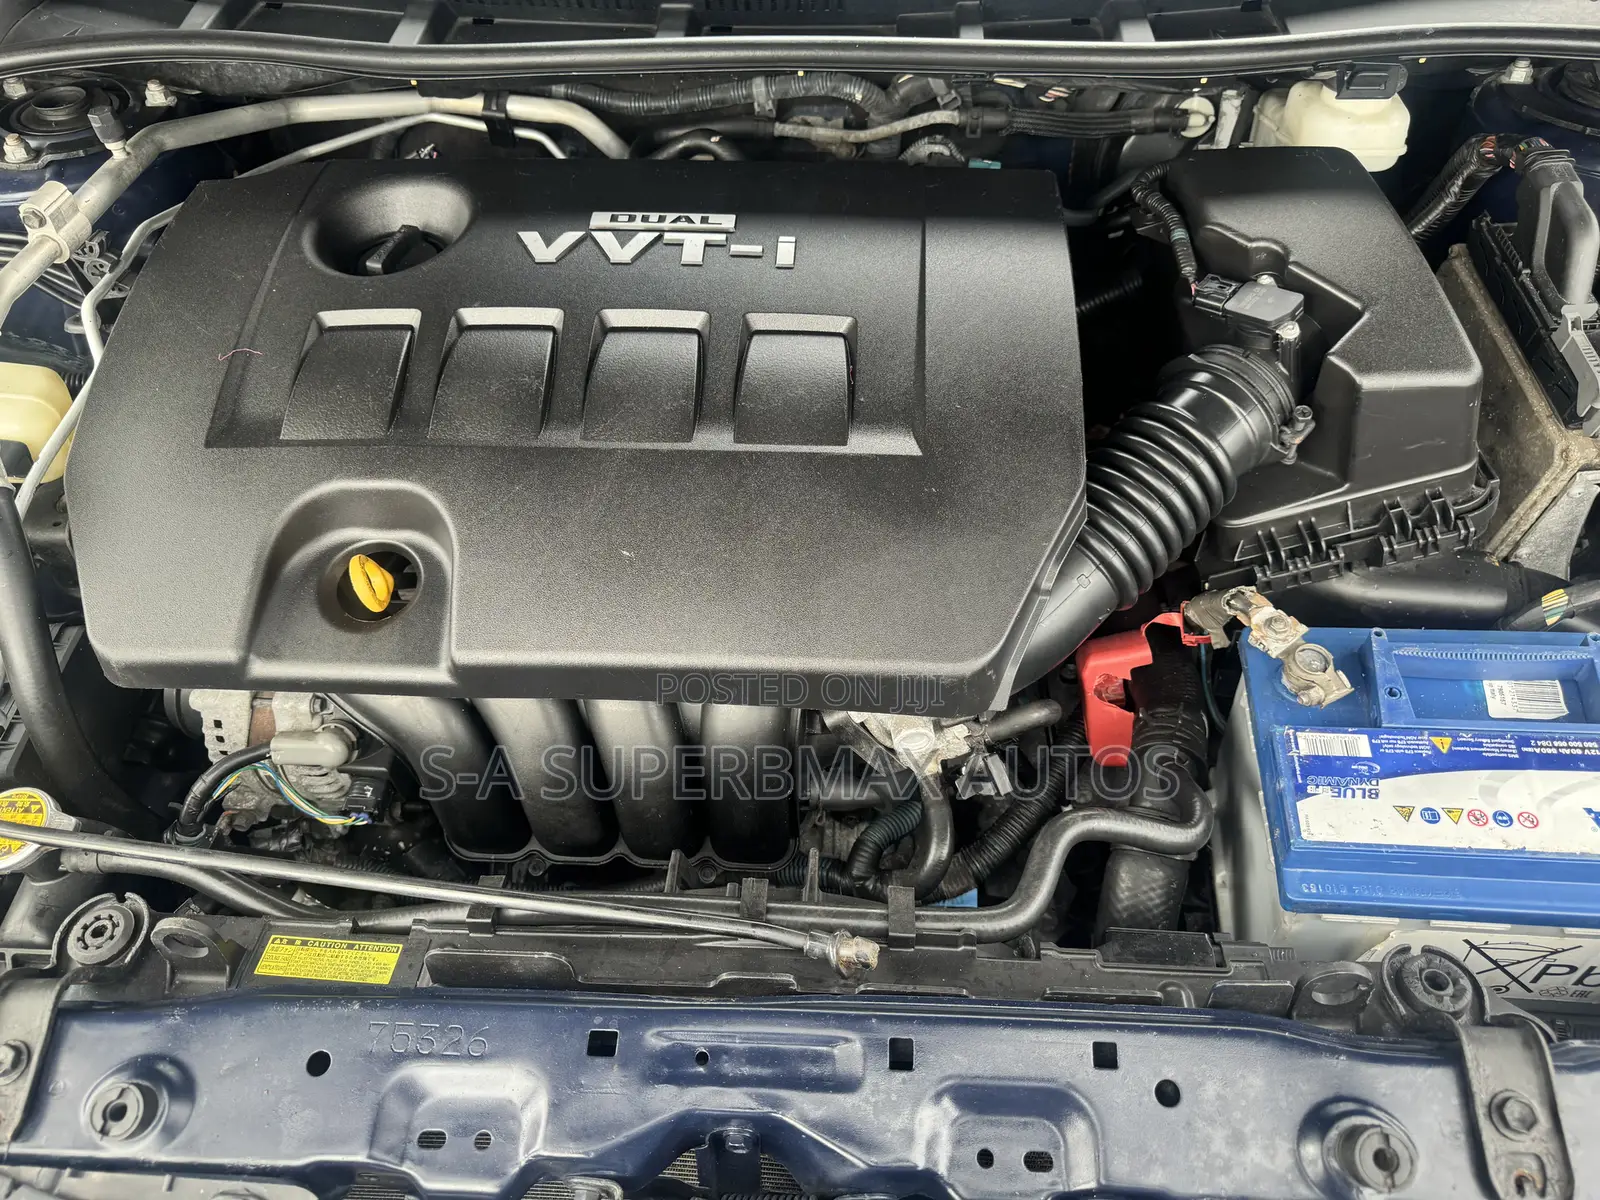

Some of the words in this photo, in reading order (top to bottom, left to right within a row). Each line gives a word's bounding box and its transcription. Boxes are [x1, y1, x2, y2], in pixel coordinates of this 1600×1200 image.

[609, 213, 723, 225] DUAL
[1306, 776, 1380, 786] DYNAMIC
[1330, 787, 1380, 799] BLUE
[307, 940, 348, 949] CAUTION
[353, 944, 398, 953] ATTENTION
[1529, 963, 1600, 988] Pb
[368, 1021, 489, 1057] 75326
